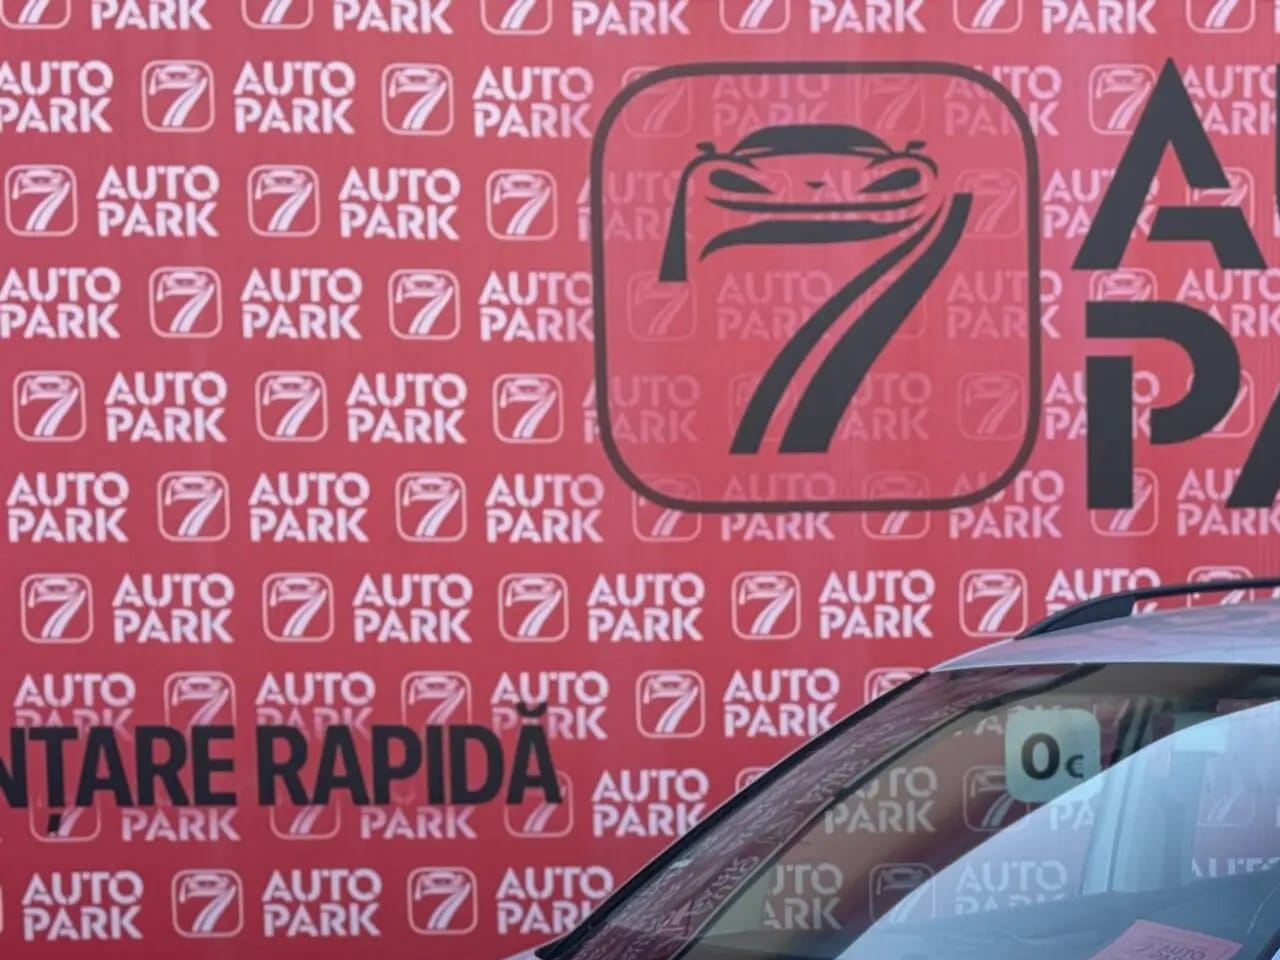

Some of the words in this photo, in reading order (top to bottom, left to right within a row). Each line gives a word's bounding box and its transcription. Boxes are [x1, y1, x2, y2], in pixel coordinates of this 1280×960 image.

[92, 0, 210, 29] PARK
[334, 0, 452, 33] PARK
[573, 0, 688, 35] PARK
[810, 0, 924, 32] PARK
[1043, 0, 1155, 33] PARK
[0, 61, 113, 95] AUTO
[234, 62, 355, 97] AUTO
[473, 67, 592, 100] AUTO
[712, 74, 828, 99] AUTO
[0, 98, 111, 132] PARK
[236, 98, 354, 133] PARK
[475, 102, 590, 137] PARK
[97, 165, 219, 200] AUTO
[339, 168, 460, 202] AUTO
[98, 202, 218, 236] PARK
[341, 204, 458, 240] PARK
[0, 267, 120, 302] AUTO
[241, 268, 362, 303] AUTO
[479, 272, 592, 305] AUTO
[716, 271, 833, 304] AUTO
[0, 304, 119, 338] PARK
[243, 304, 360, 339] PARK
[480, 307, 593, 341] PARK
[717, 307, 810, 340] PAR
[105, 372, 227, 406] AUTO
[347, 373, 467, 407] AUTO
[851, 372, 931, 404] UTO
[107, 407, 226, 442] PARK
[348, 407, 465, 443] PARK
[842, 407, 929, 440] ARK
[1045, 407, 1151, 439] PAK
[7, 472, 129, 506] AUTO
[249, 472, 369, 506] AUTO
[486, 474, 603, 507] AUTO
[8, 508, 127, 542] PARK
[251, 508, 368, 542] PARK
[487, 509, 602, 542] PARK
[721, 512, 834, 541] PARK
[950, 504, 1062, 539] PARK
[112, 573, 234, 607] AUTO
[353, 574, 472, 607] AUTO
[587, 573, 704, 606] AUTO
[819, 570, 934, 603] AUTO
[1045, 568, 1160, 600] AUTO
[114, 609, 232, 642] PARK
[355, 609, 471, 642] PARK
[589, 608, 702, 641] PARK
[820, 604, 932, 638] PARK
[15, 673, 136, 706] AUTO
[255, 672, 376, 706] AUTO
[490, 671, 609, 704] AUTO
[724, 668, 839, 702] AUTO
[725, 703, 836, 737] PARK
[256, 702, 562, 807] RAPIDĂ
[592, 768, 708, 802] AUTO
[121, 807, 240, 841] PARK
[360, 807, 477, 841] PARK
[594, 803, 706, 837] PARK
[824, 802, 937, 834] PARK
[22, 871, 143, 905] AUTO
[262, 868, 382, 901] AUTO
[496, 866, 613, 900] AUTO
[955, 860, 1067, 892] AUTO
[24, 906, 141, 940] PARK
[264, 903, 380, 936] PARK
[764, 898, 844, 929] ARK
